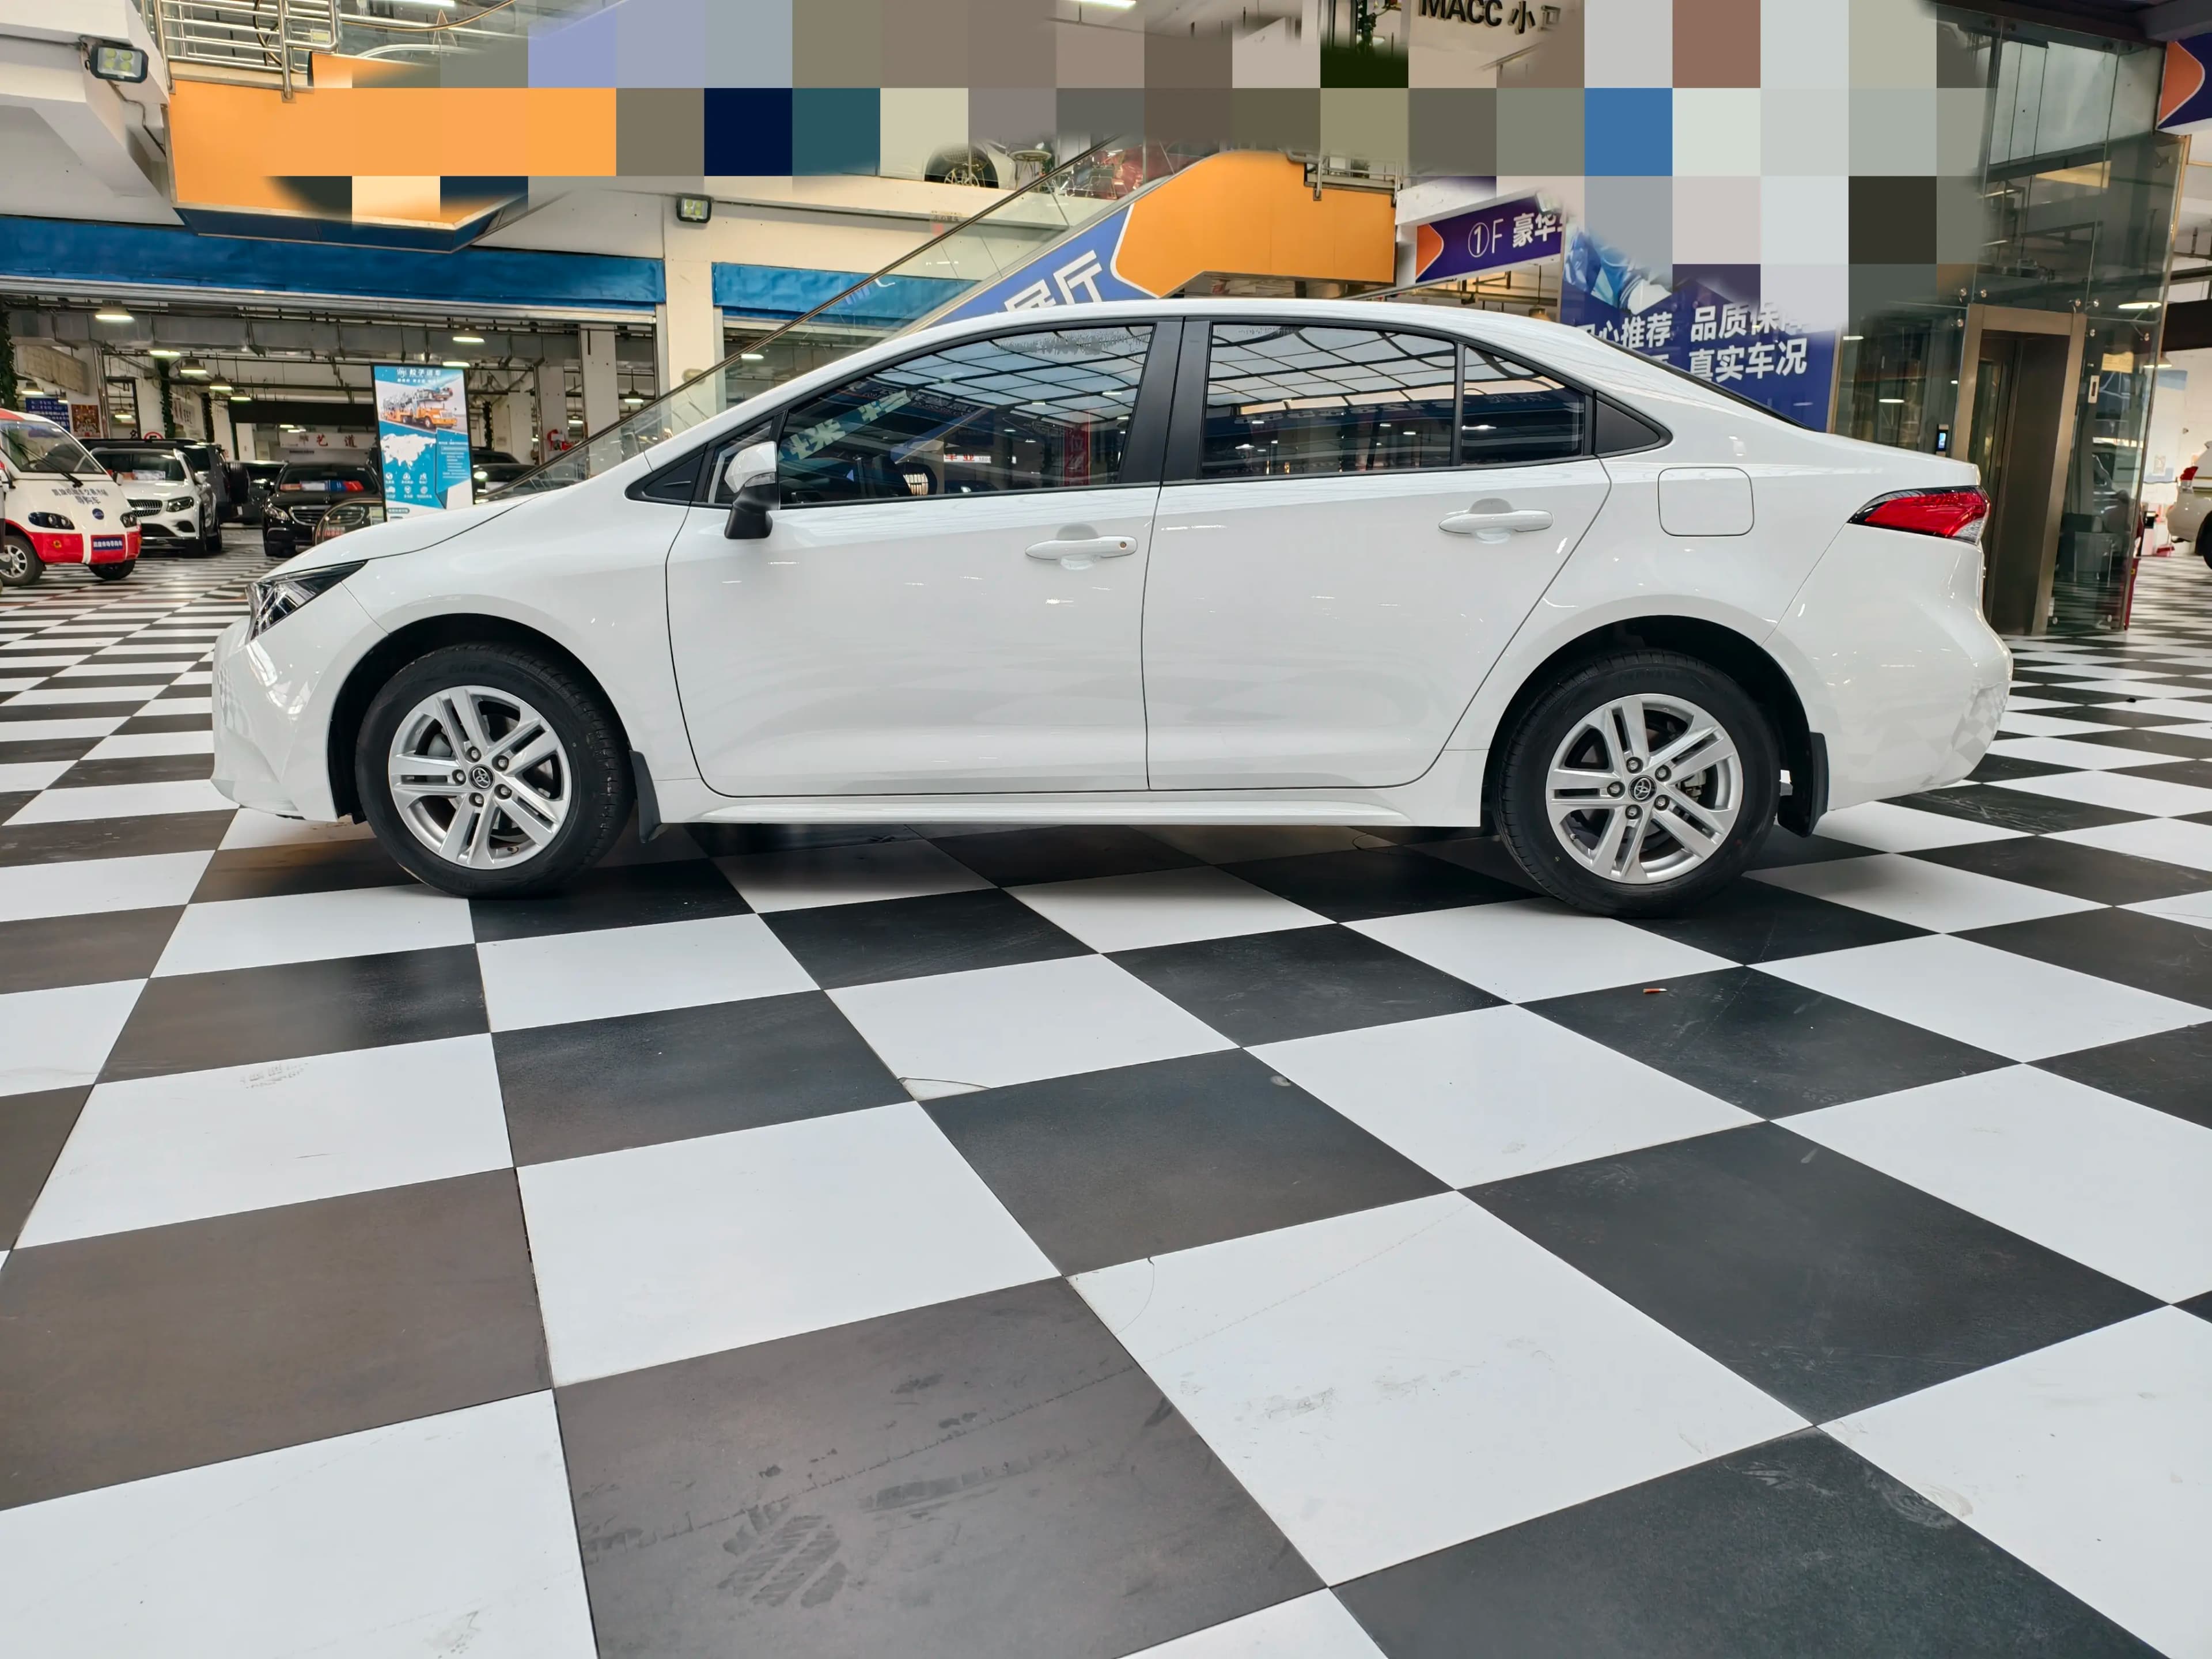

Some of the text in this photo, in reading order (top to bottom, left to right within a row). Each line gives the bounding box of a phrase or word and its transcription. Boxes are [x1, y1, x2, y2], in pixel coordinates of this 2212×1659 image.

[1419, 0, 1503, 26] MACC
[1512, 213, 1562, 248] 豪华
[1689, 338, 1807, 382] 真实车况
